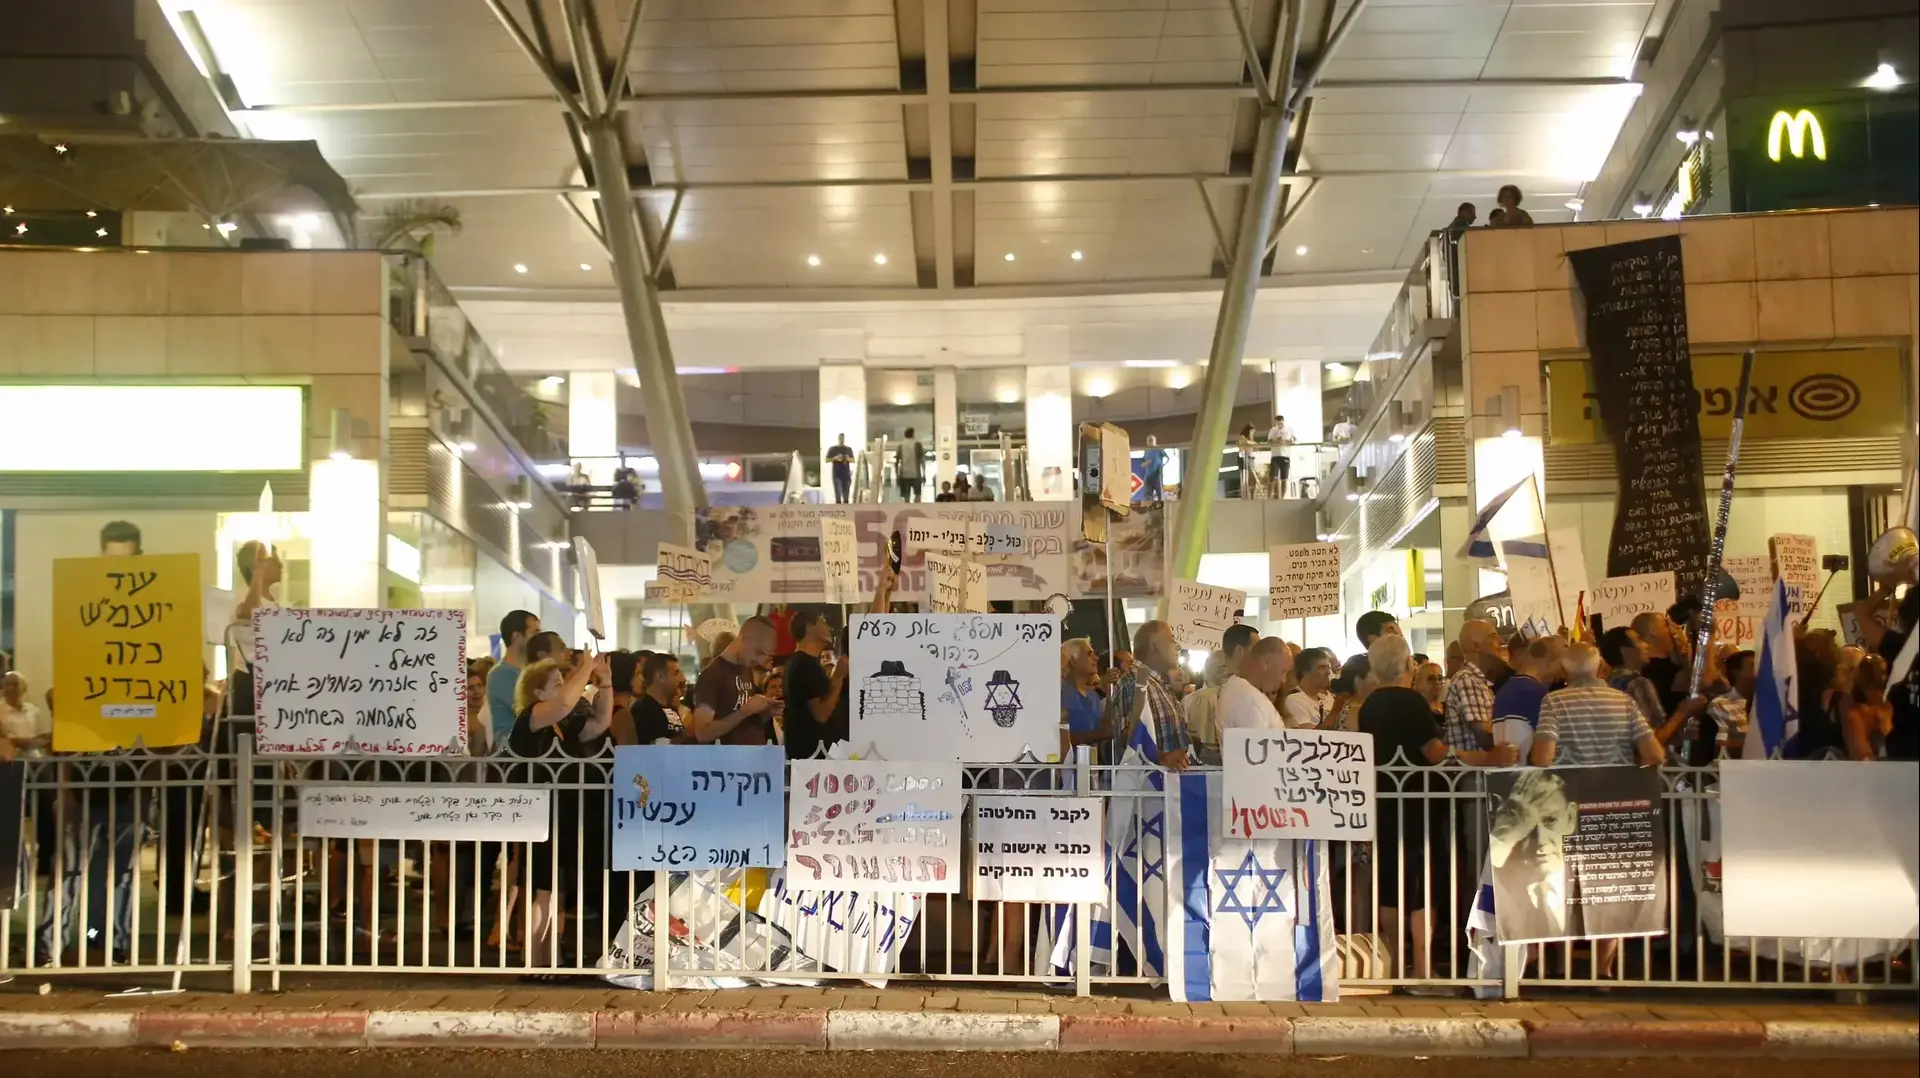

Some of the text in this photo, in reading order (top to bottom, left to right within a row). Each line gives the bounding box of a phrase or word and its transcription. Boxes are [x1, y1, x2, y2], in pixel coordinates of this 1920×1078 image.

[1020, 510, 1064, 529] שנה
[106, 572, 158, 597] עוד
[1179, 585, 1212, 601] נתניהו
[856, 619, 897, 640] העם
[906, 619, 941, 639] את
[281, 619, 438, 660] זה לא ימין זה לא
[105, 641, 163, 666] כזה
[920, 643, 980, 661] היהודי
[306, 676, 363, 700] המדינה
[369, 675, 418, 693] אזרחי
[428, 670, 449, 693] כל
[274, 706, 418, 730] למלחמה בשחיתות
[1245, 731, 1366, 766] מנדלבליט
[1326, 768, 1360, 784] ושי
[691, 770, 771, 806] חקירה
[978, 807, 1090, 823] לקבל החלטה:
[1230, 796, 1367, 839] של השטן!
[708, 848, 751, 867] מתווה
[978, 842, 1091, 854] כתבי אישום או
[978, 866, 1089, 880] סגירת התיקים
